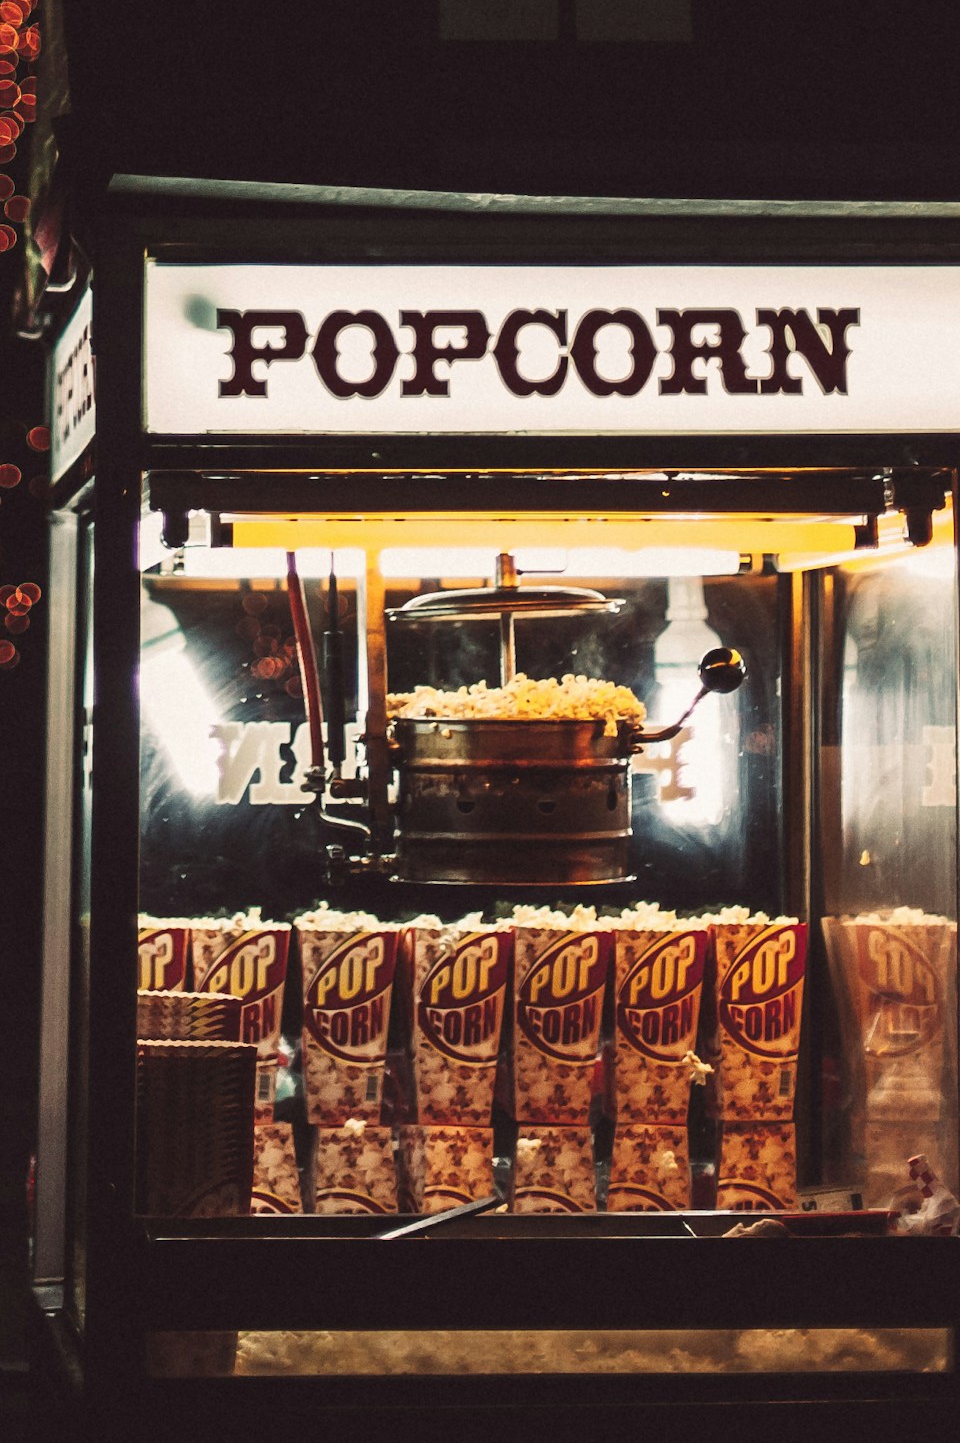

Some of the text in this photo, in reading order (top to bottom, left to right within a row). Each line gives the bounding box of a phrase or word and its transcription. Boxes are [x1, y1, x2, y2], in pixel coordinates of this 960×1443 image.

[216, 306, 861, 399] POPCORN
[209, 935, 276, 998] POP
[317, 936, 385, 1007] POP
[430, 936, 499, 1005] POP
[530, 936, 599, 1004] POP
[629, 935, 696, 1006] POP
[731, 929, 796, 1001] POP
[242, 995, 276, 1044] RN
[316, 994, 384, 1048] CORN
[429, 994, 497, 1047] CORN
[528, 994, 596, 1046] CORN
[628, 994, 695, 1046] CORN
[730, 989, 796, 1042] CORN
